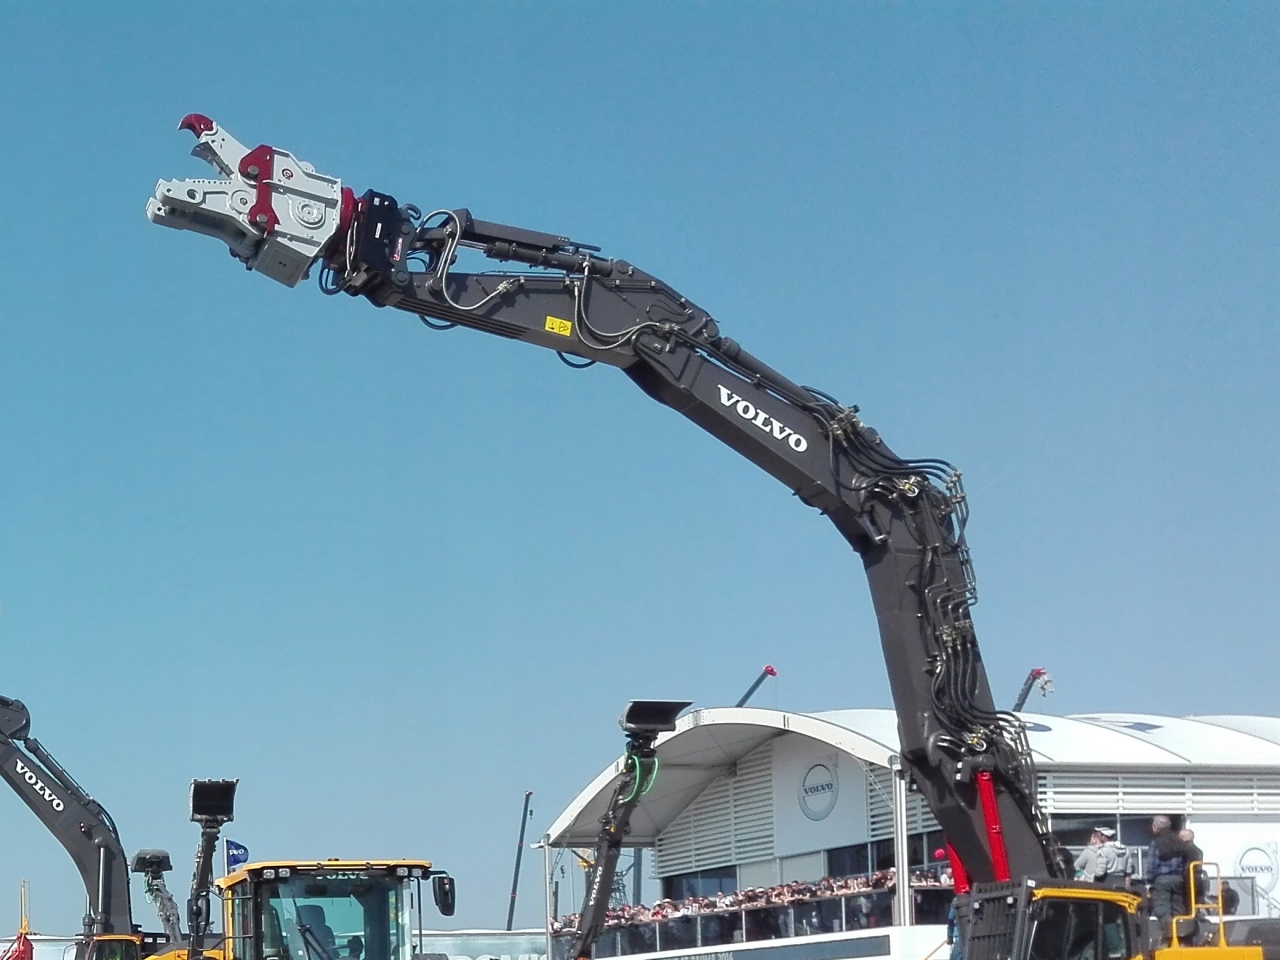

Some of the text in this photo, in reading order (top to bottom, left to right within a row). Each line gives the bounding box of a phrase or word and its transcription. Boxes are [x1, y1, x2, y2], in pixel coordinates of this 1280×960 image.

[718, 384, 808, 453] VOLVO
[15, 758, 65, 812] VOLVO
[803, 783, 833, 794] VOLVO
[313, 871, 369, 880] OLVO
[1241, 865, 1273, 873] VOLVO
[589, 866, 602, 906] VOLVO
